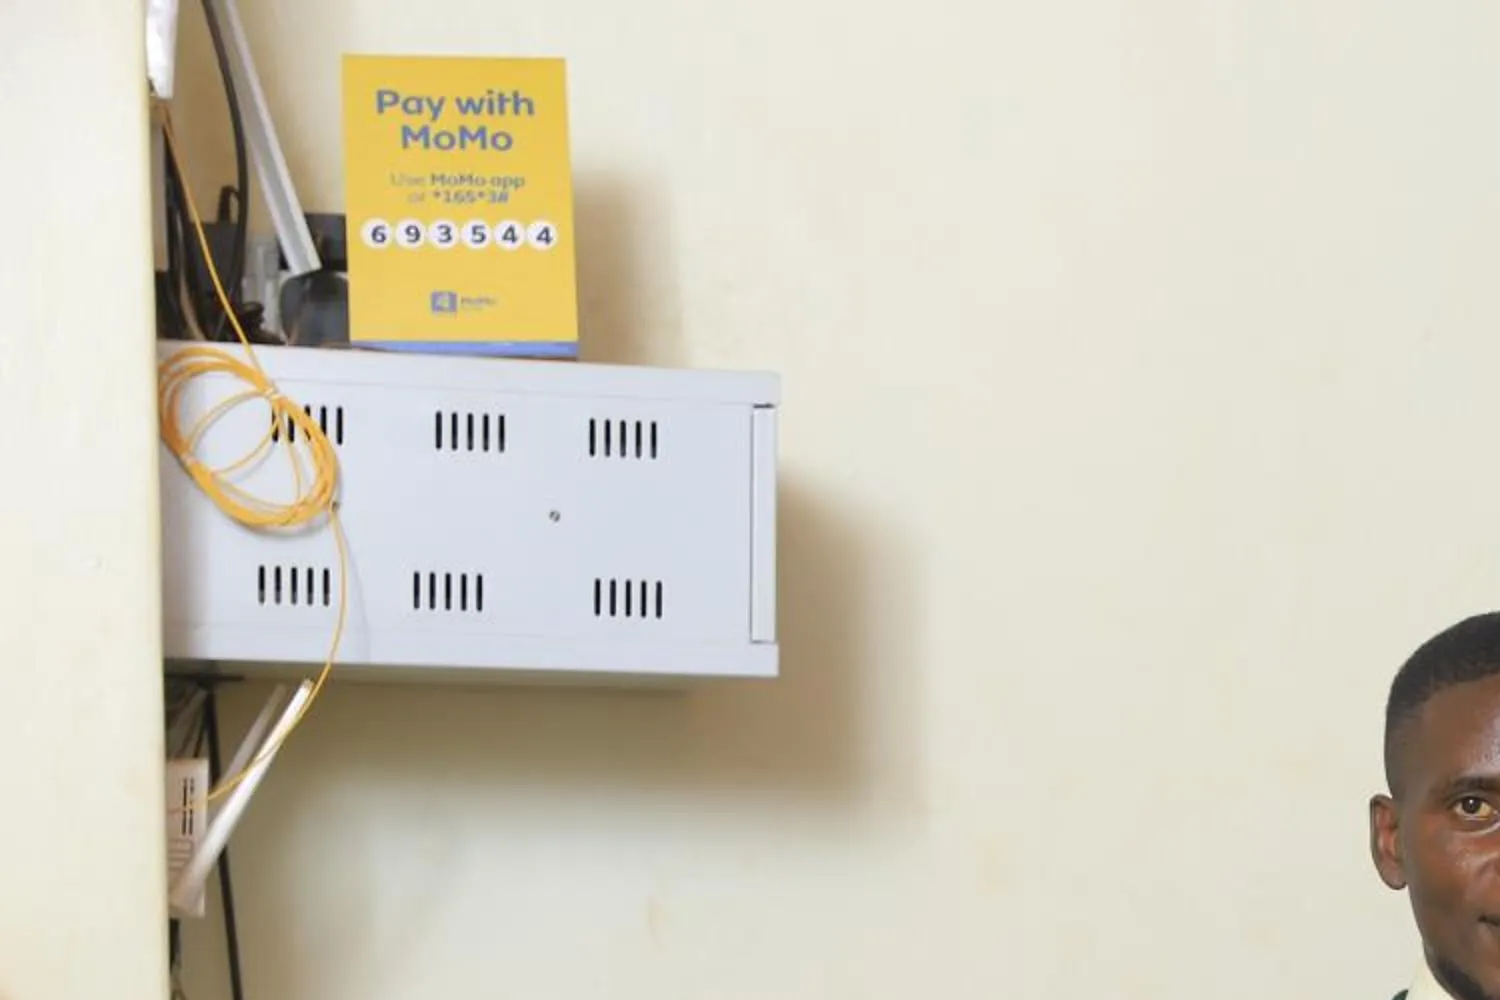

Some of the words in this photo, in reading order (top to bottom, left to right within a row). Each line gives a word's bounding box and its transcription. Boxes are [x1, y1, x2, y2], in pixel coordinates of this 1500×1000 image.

[376, 89, 446, 122] Pay
[455, 88, 535, 117] with
[400, 124, 513, 151] MoMo
[430, 172, 487, 188] MoMo
[489, 175, 526, 191] app
